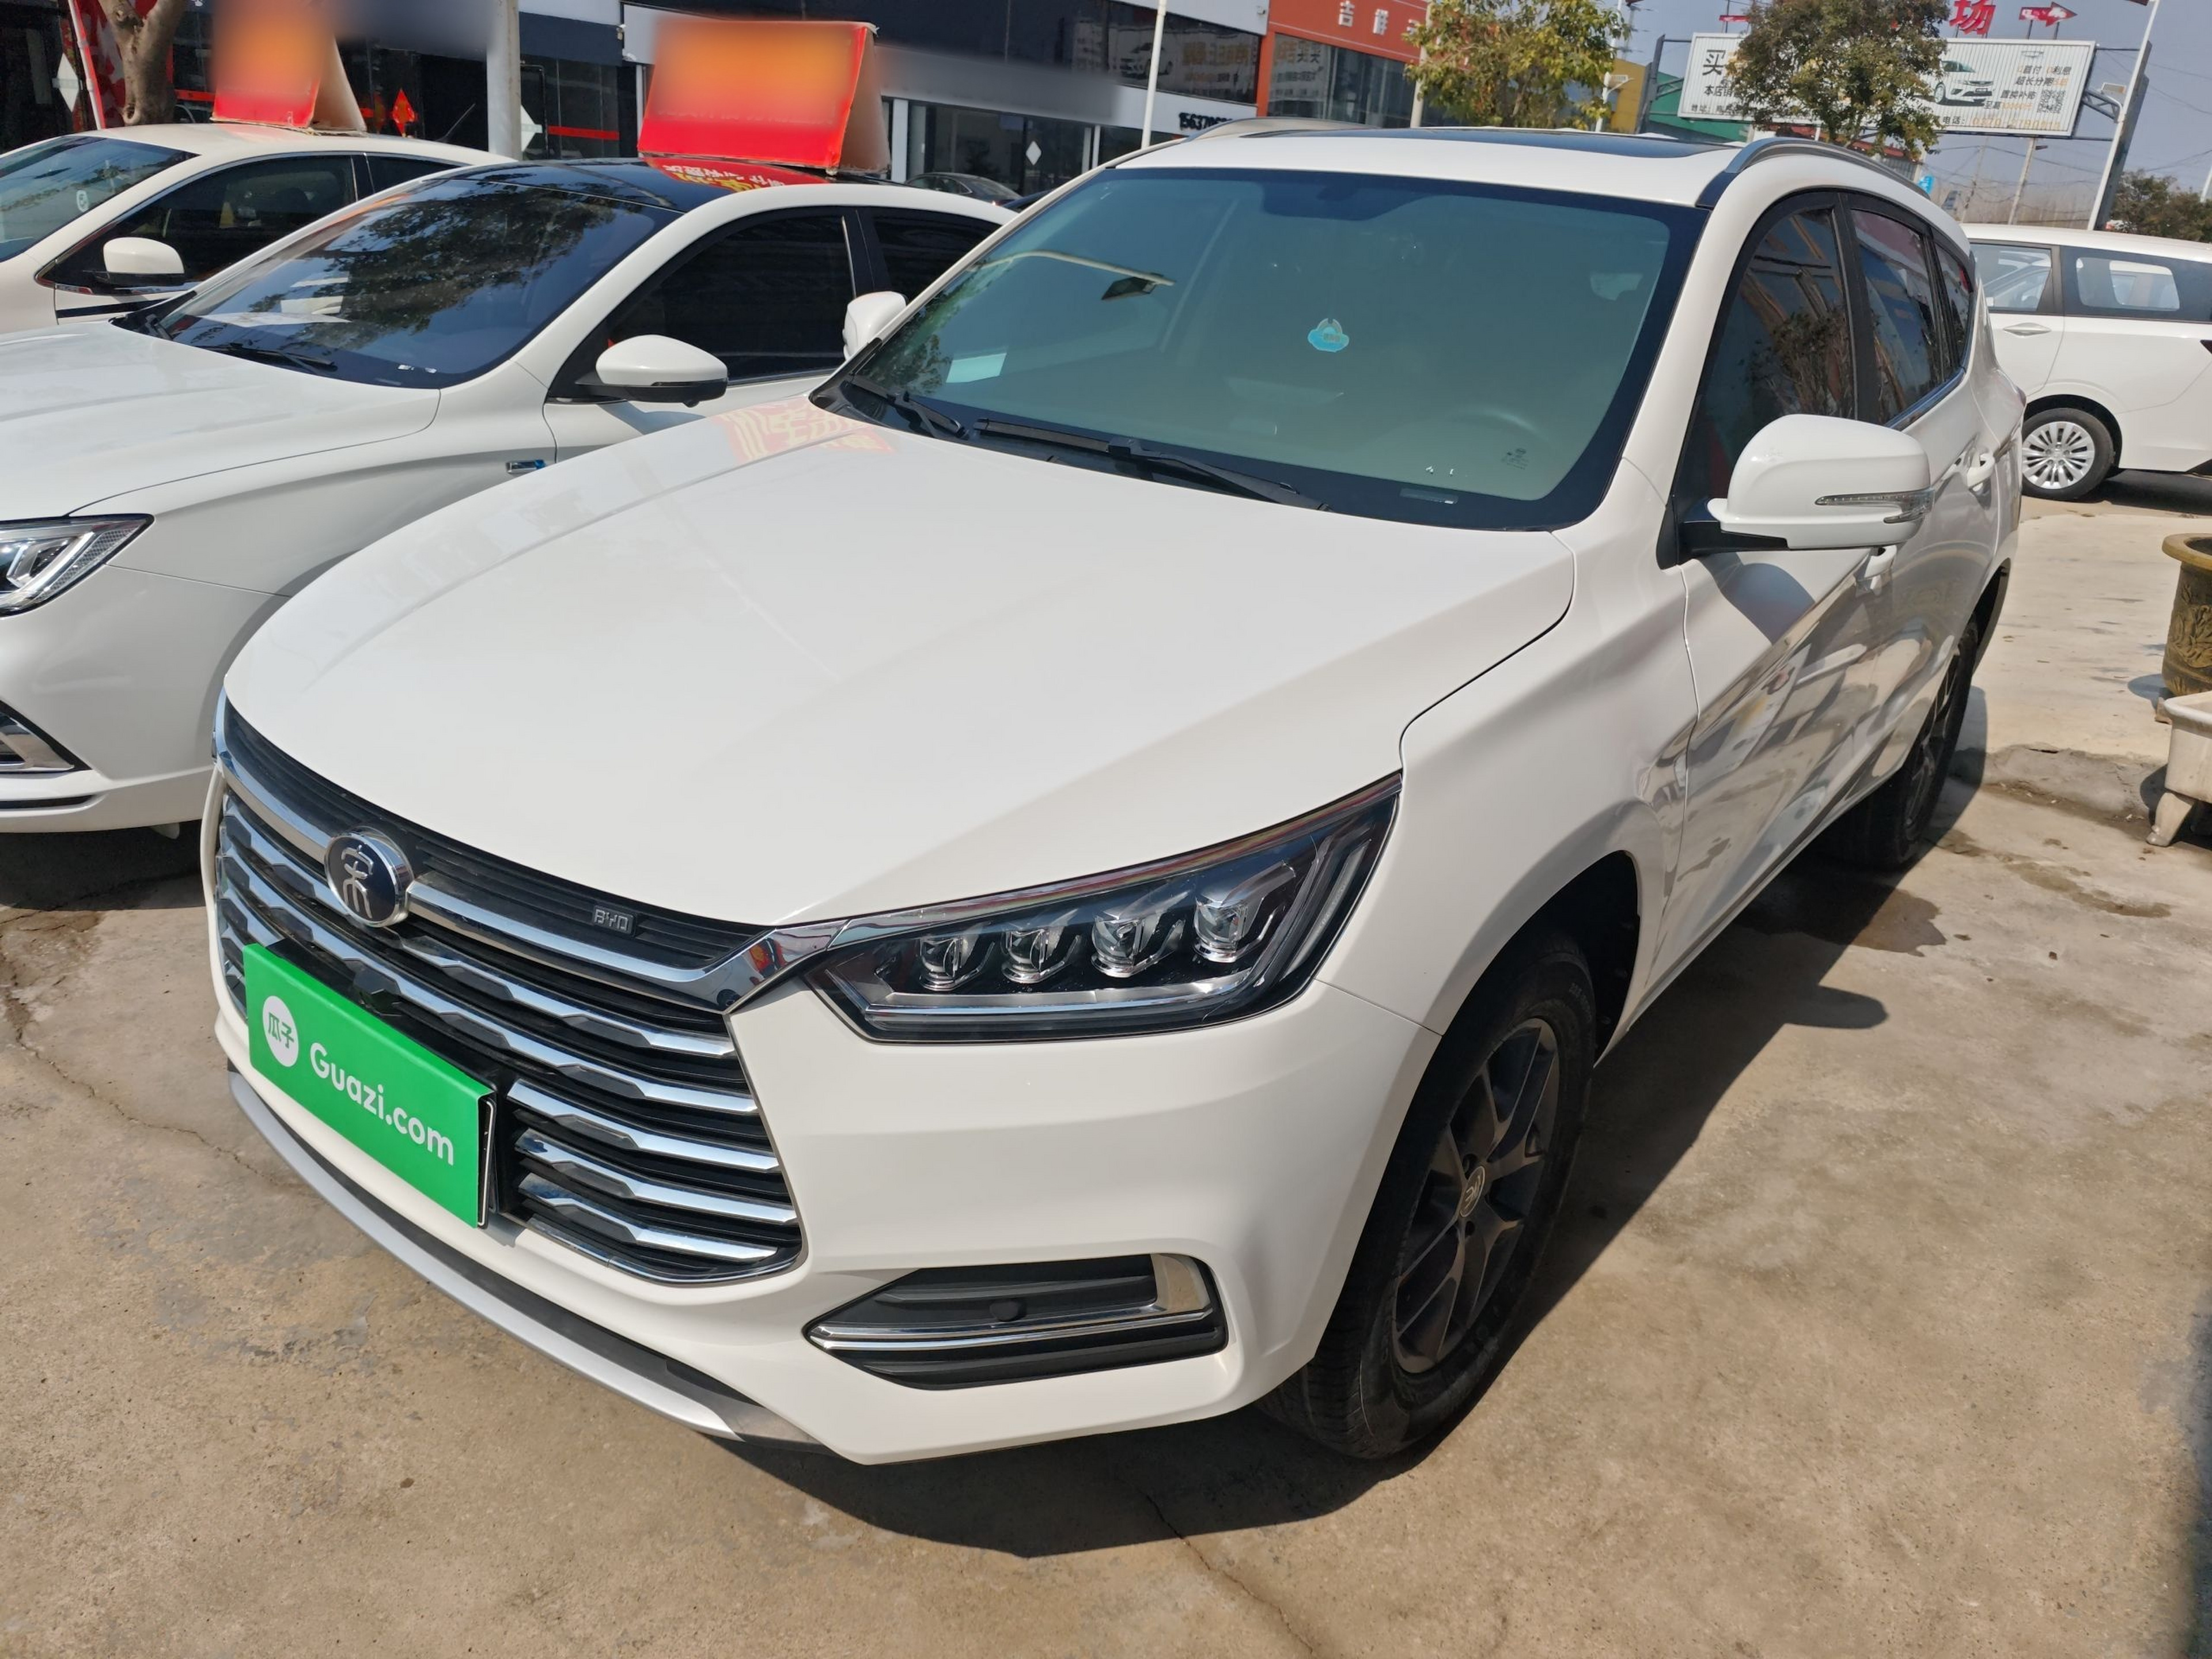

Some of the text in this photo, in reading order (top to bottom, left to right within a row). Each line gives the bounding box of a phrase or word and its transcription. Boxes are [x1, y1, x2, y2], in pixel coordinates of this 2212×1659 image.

[594, 909, 628, 931] BYD
[268, 1012, 454, 1166] 瓜子 Guazi.com
